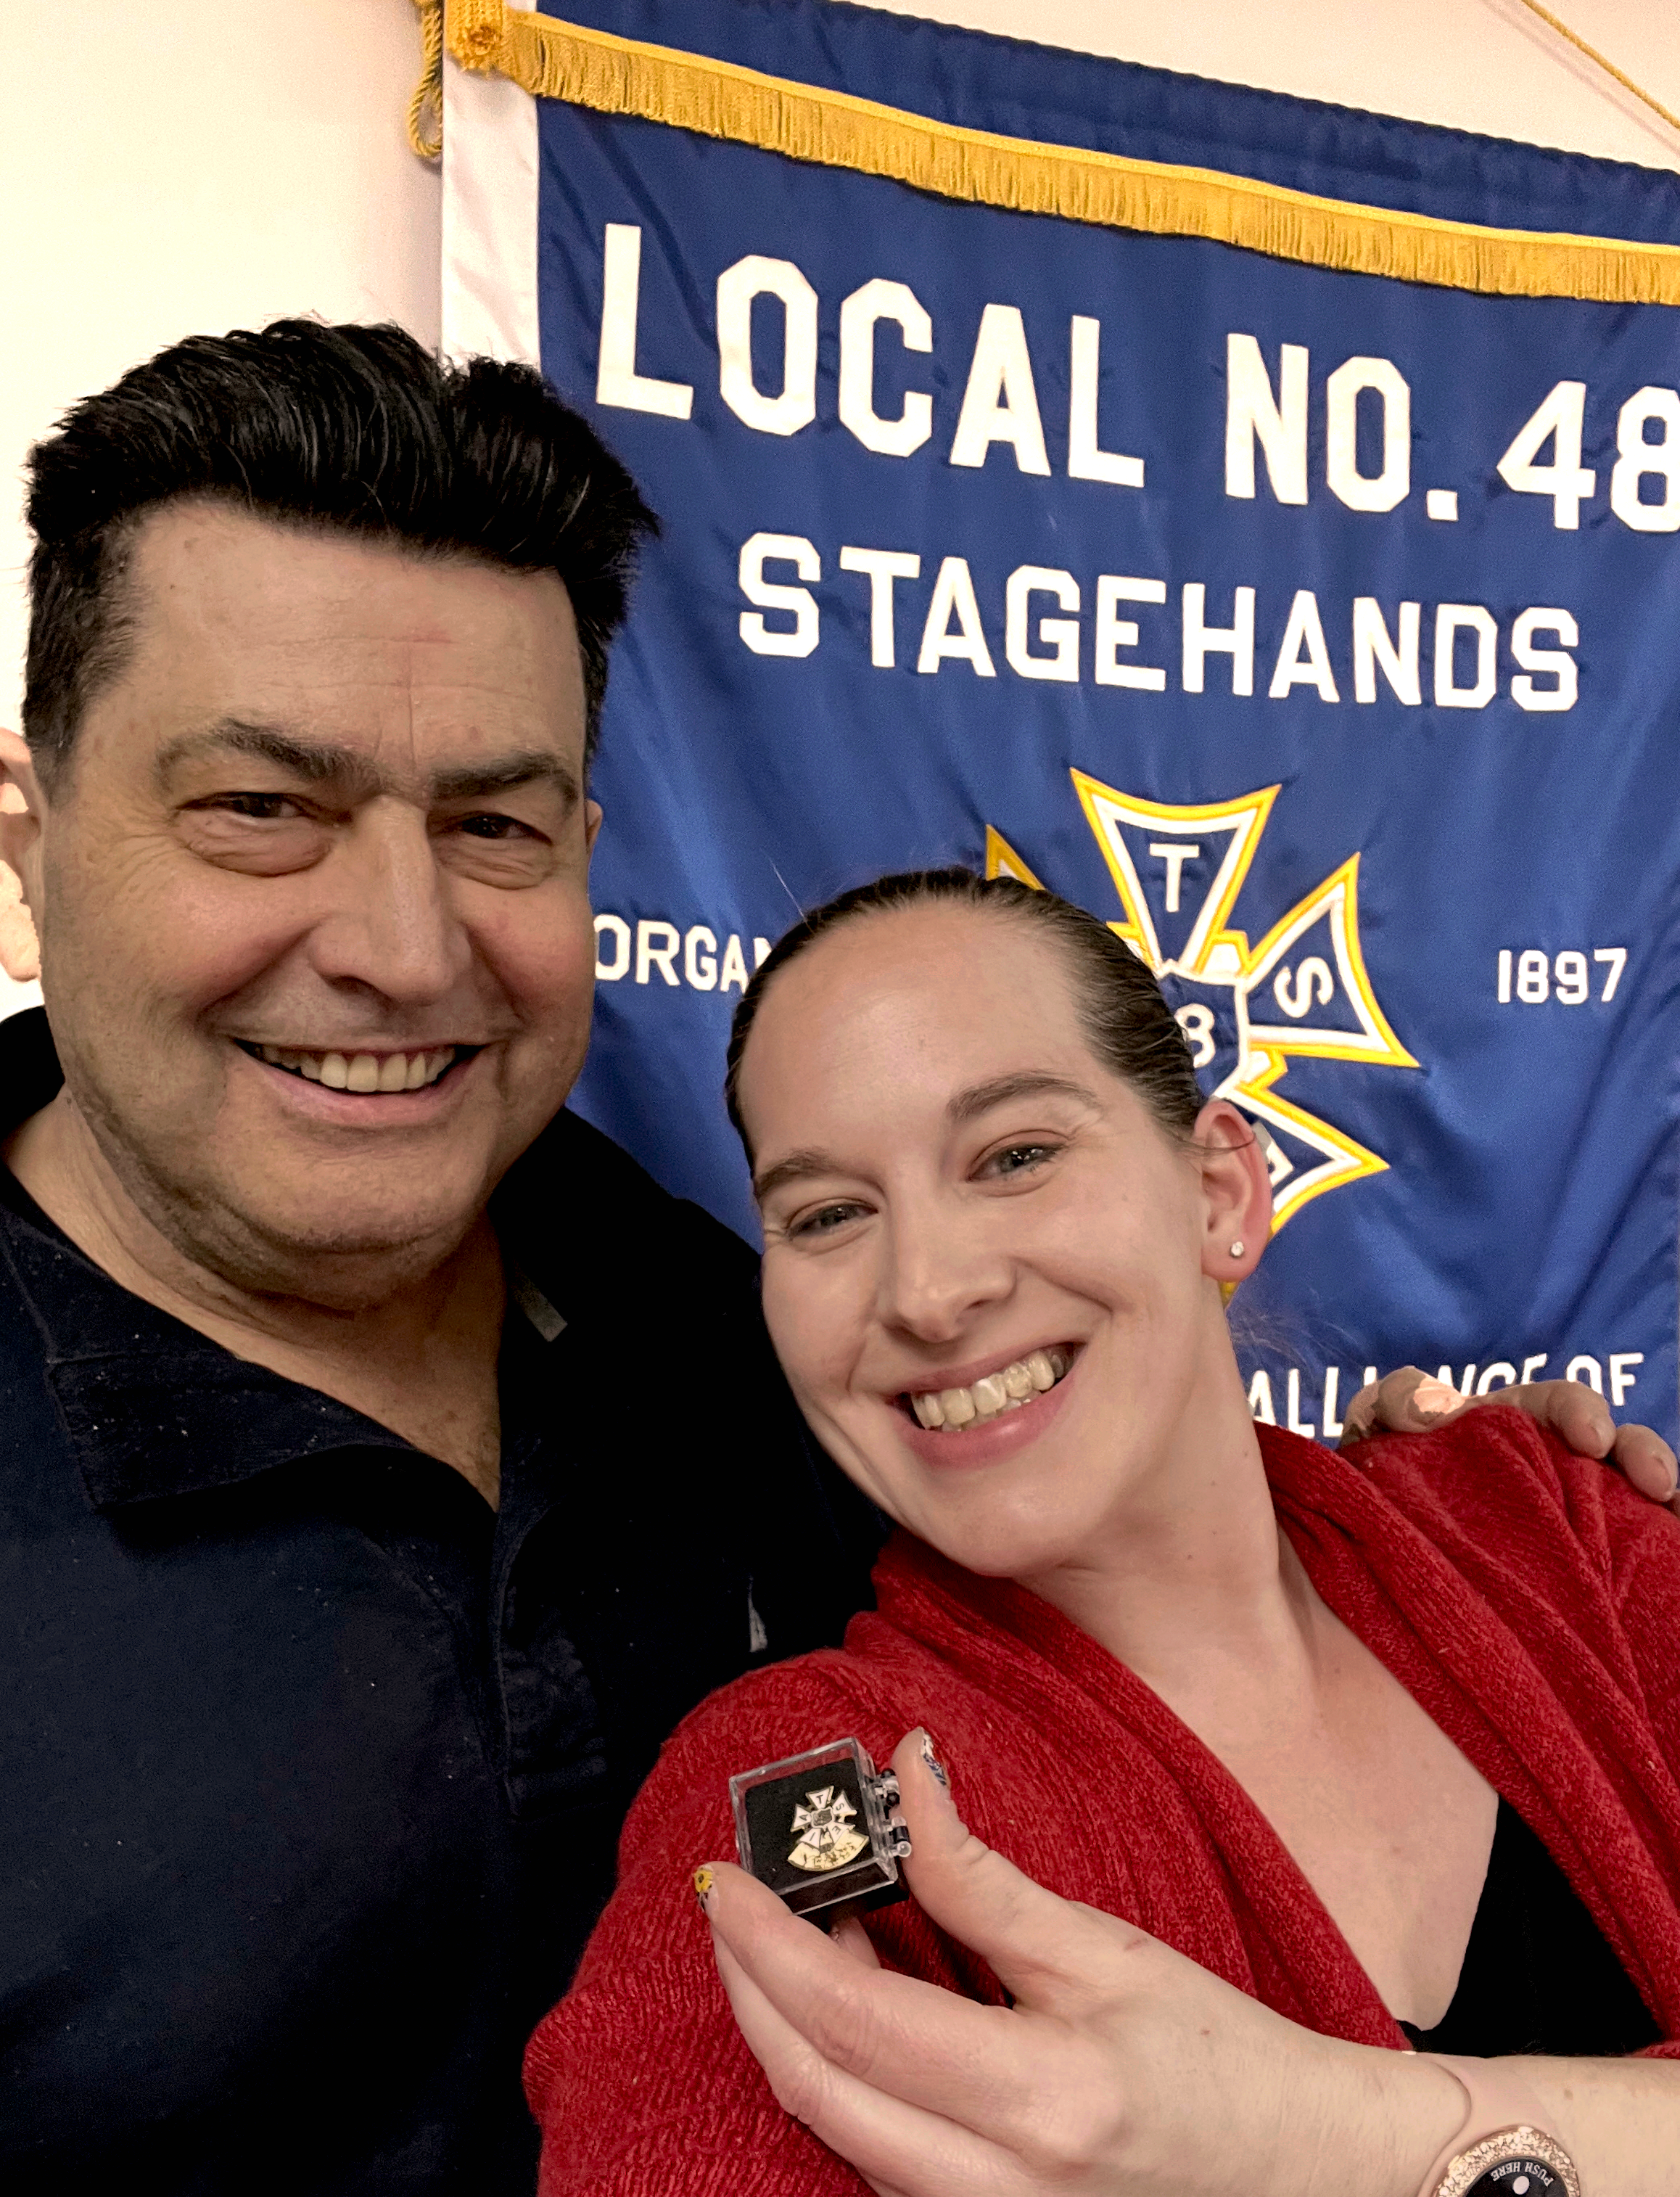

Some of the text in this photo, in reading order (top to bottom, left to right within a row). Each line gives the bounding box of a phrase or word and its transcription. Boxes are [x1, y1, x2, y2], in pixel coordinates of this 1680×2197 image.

[596, 223, 1680, 533] LOCAL NO. 48
[738, 533, 1579, 711] STAGEHANDS
[1149, 843, 1199, 912] T
[1274, 957, 1333, 1017] S
[1498, 948, 1627, 1005] 1897
[1491, 2161, 1555, 2187] PUSH HERE
